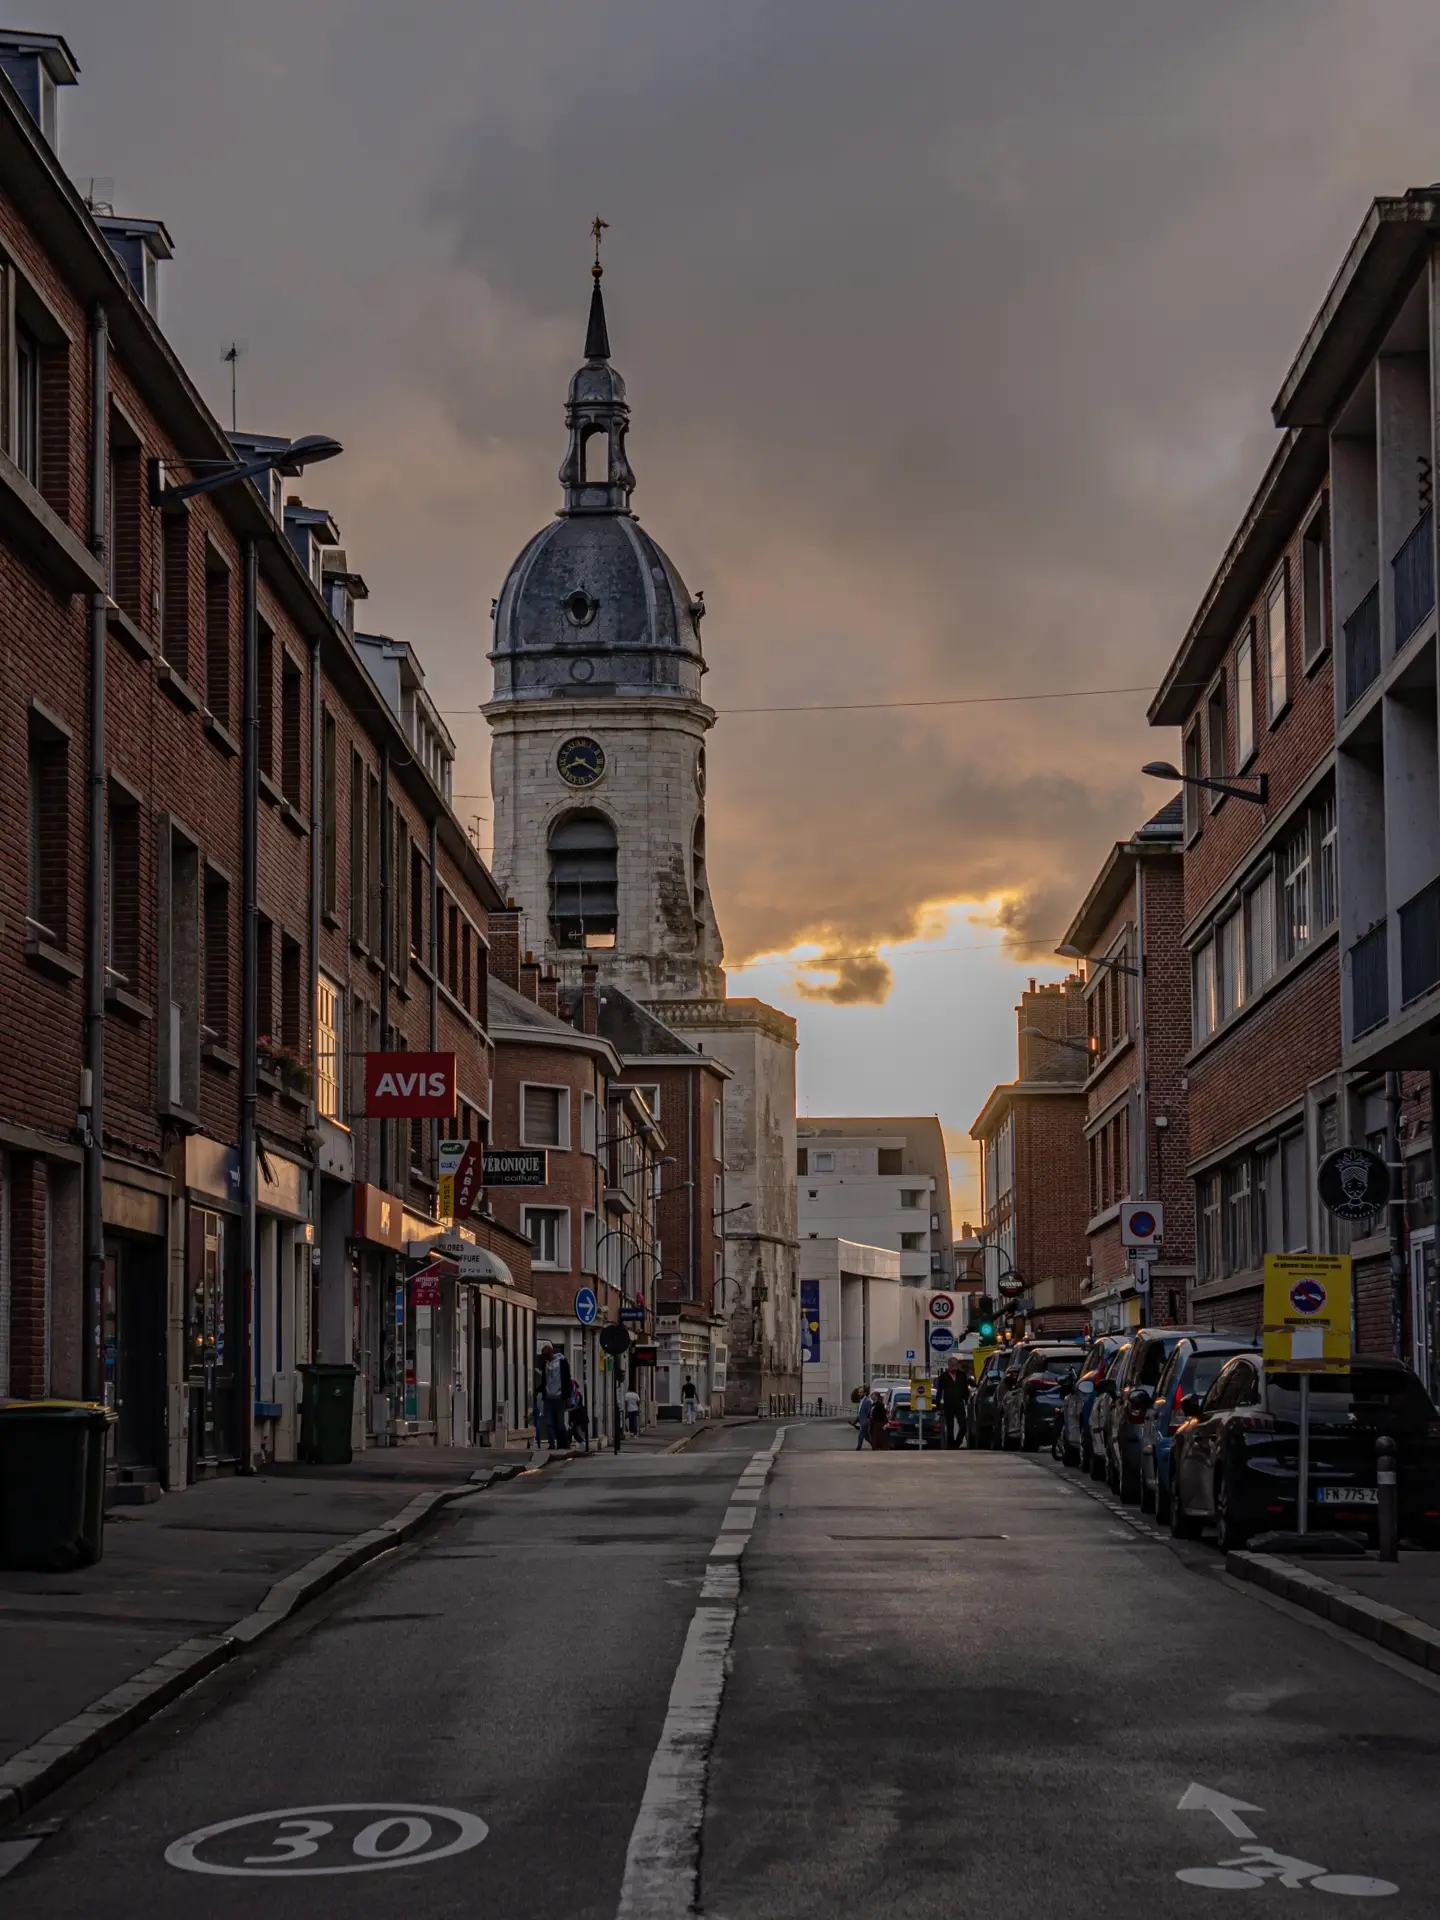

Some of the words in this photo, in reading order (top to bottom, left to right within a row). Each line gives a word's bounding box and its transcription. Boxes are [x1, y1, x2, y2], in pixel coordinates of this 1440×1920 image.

[375, 1072, 446, 1097] AVIS
[482, 1156, 539, 1174] VÉRONIQUE
[459, 1156, 477, 1206] TABAC
[436, 1243, 464, 1252] OLORES
[458, 1254, 481, 1263] FFURE
[935, 1302, 949, 1313] 30
[1325, 1488, 1380, 1501] FN-775-Z
[243, 1816, 432, 1865] 30
